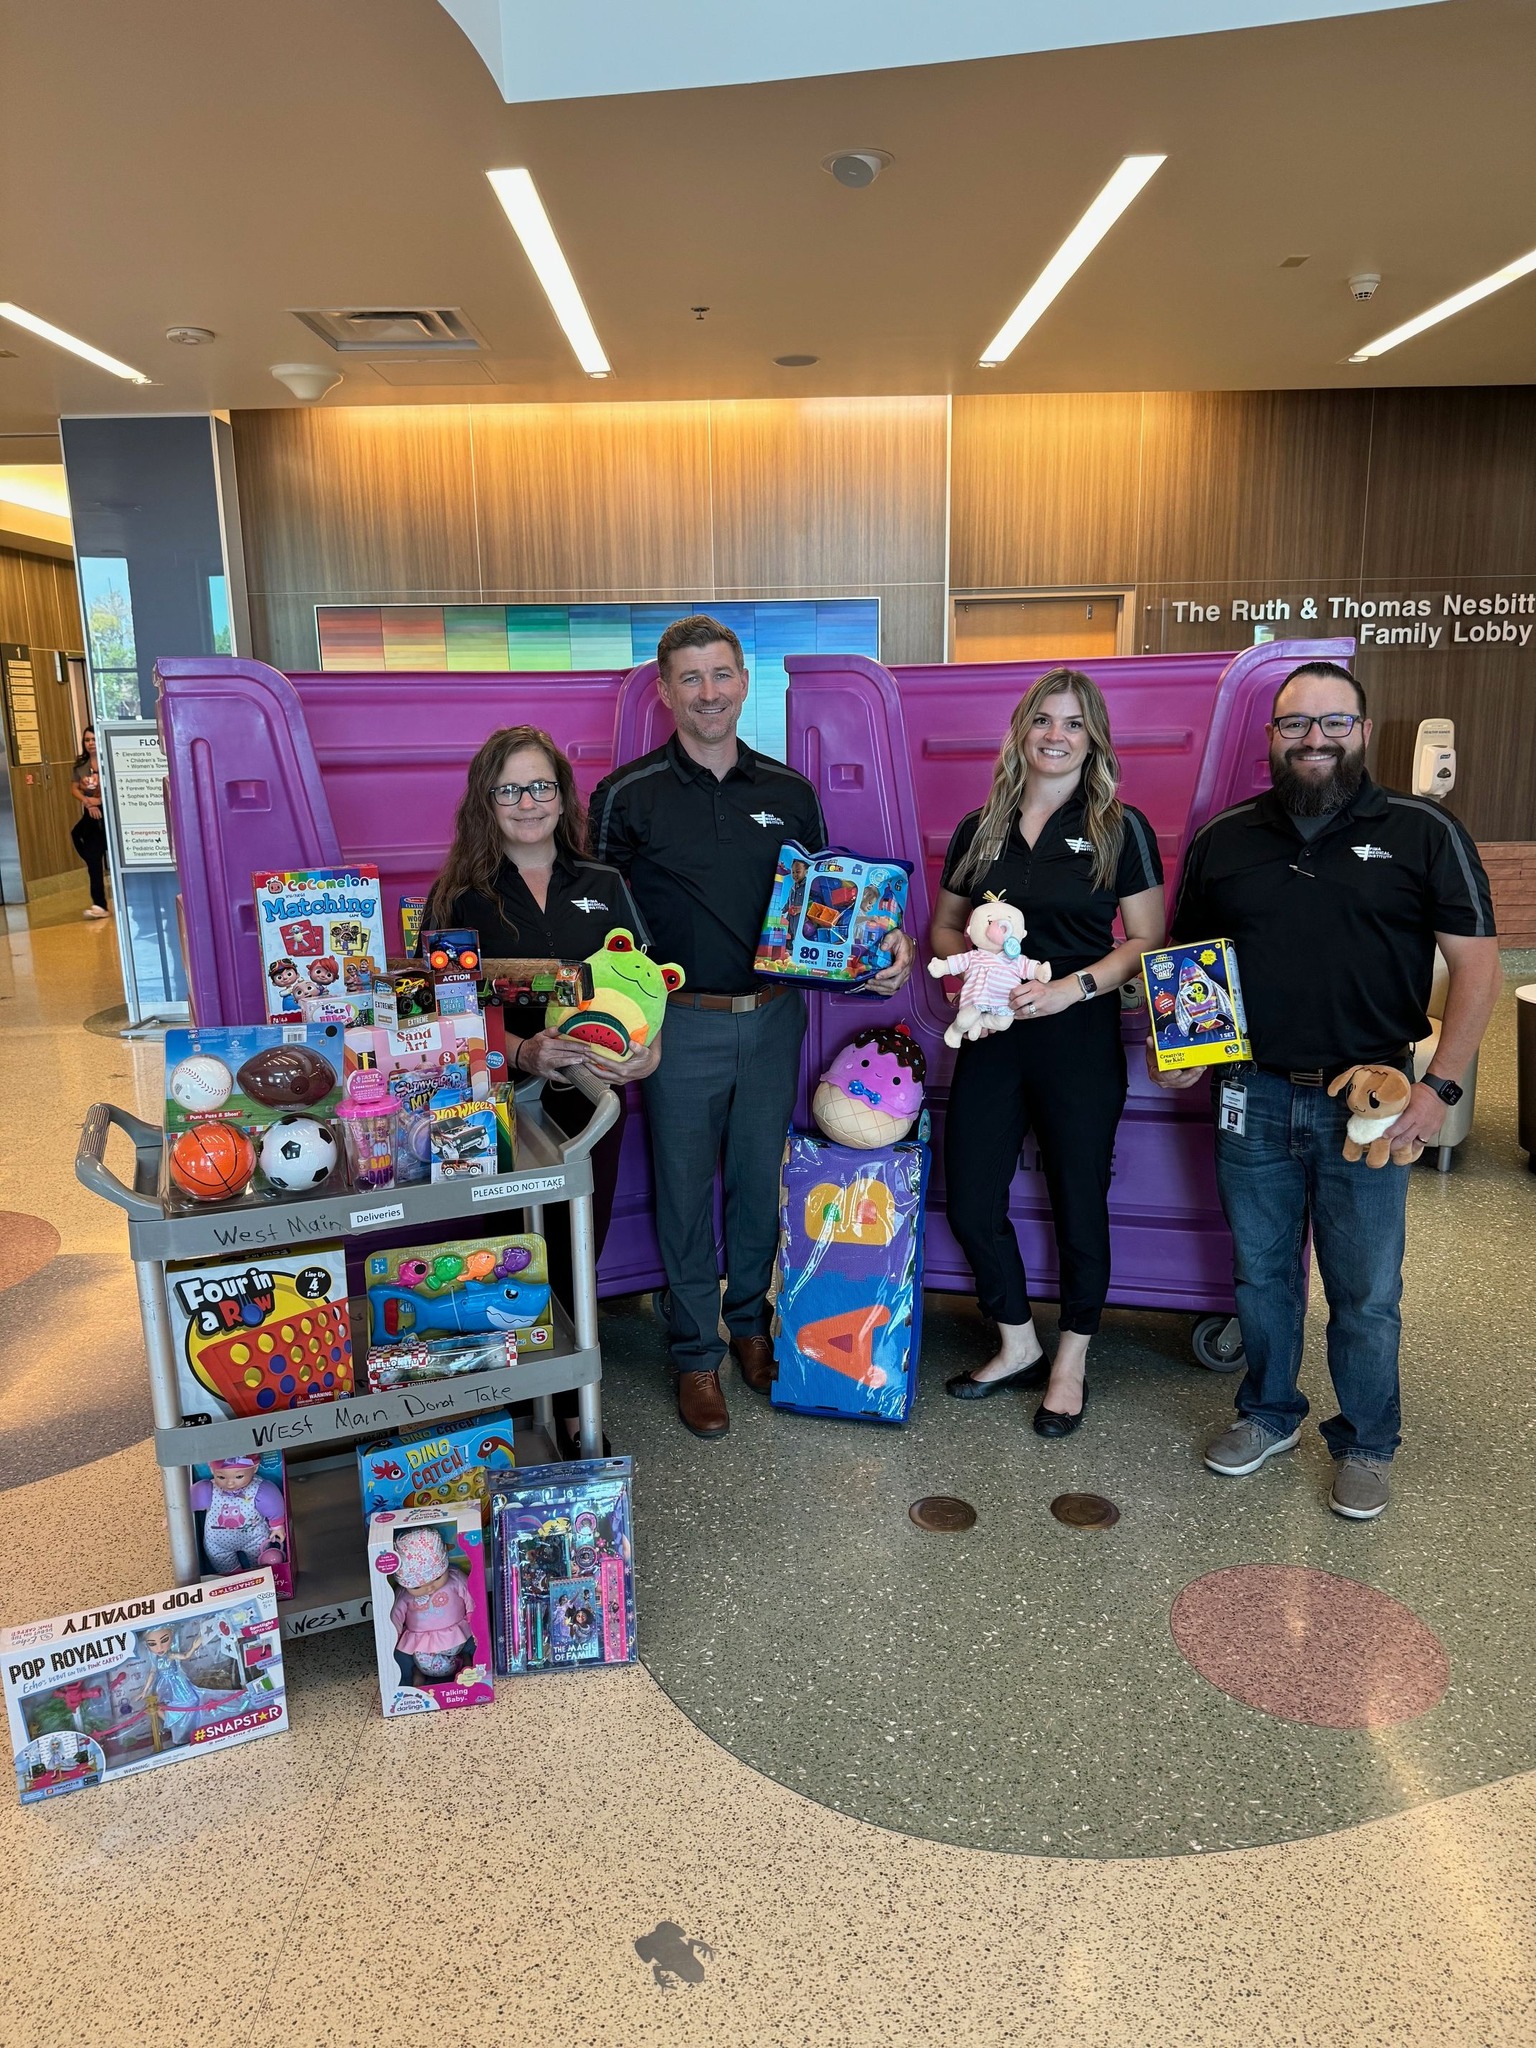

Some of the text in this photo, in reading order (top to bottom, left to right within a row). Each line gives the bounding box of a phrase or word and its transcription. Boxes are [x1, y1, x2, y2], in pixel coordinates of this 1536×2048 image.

[1173, 593, 1535, 623] The Ruth & Thomas Nesbitt
[1359, 621, 1533, 648] Family Lobby
[262, 893, 376, 922] Matching
[800, 946, 844, 960] 80 BIG
[443, 974, 470, 982] ACTION
[375, 1001, 394, 1010] EXTREME
[408, 1015, 428, 1026] EXTREME
[397, 1028, 432, 1042] Sand
[405, 1040, 428, 1052] Art
[443, 1052, 450, 1063] 8
[436, 1109, 458, 1120] HOT
[373, 1142, 388, 1157] NO
[371, 1154, 391, 1169] BAD
[368, 1166, 393, 1185] DAYS
[473, 1178, 563, 1198] PLEASE DO NOT TAKE
[356, 1206, 401, 1224] Deliveries
[213, 1214, 342, 1246] West Main
[374, 1264, 385, 1274] 3+
[180, 1270, 273, 1310] Four in
[309, 1278, 319, 1290] 4
[202, 1311, 219, 1332] a
[532, 1330, 546, 1341] $5
[797, 1304, 892, 1388] A
[370, 1360, 396, 1370] HELLO
[252, 1415, 314, 1448] West
[335, 1406, 389, 1430] Main
[464, 1386, 512, 1403] Take
[400, 1416, 480, 1445] DINO CATCH!
[406, 1439, 450, 1470] DINO
[411, 1444, 469, 1490] CATCH!
[62, 1588, 203, 1636] POP ROYALTY
[287, 1608, 349, 1635] West
[566, 1650, 599, 1660] FAMILY
[568, 1642, 598, 1651] MAGIC
[9, 1632, 127, 1685] POP ROYALTY
